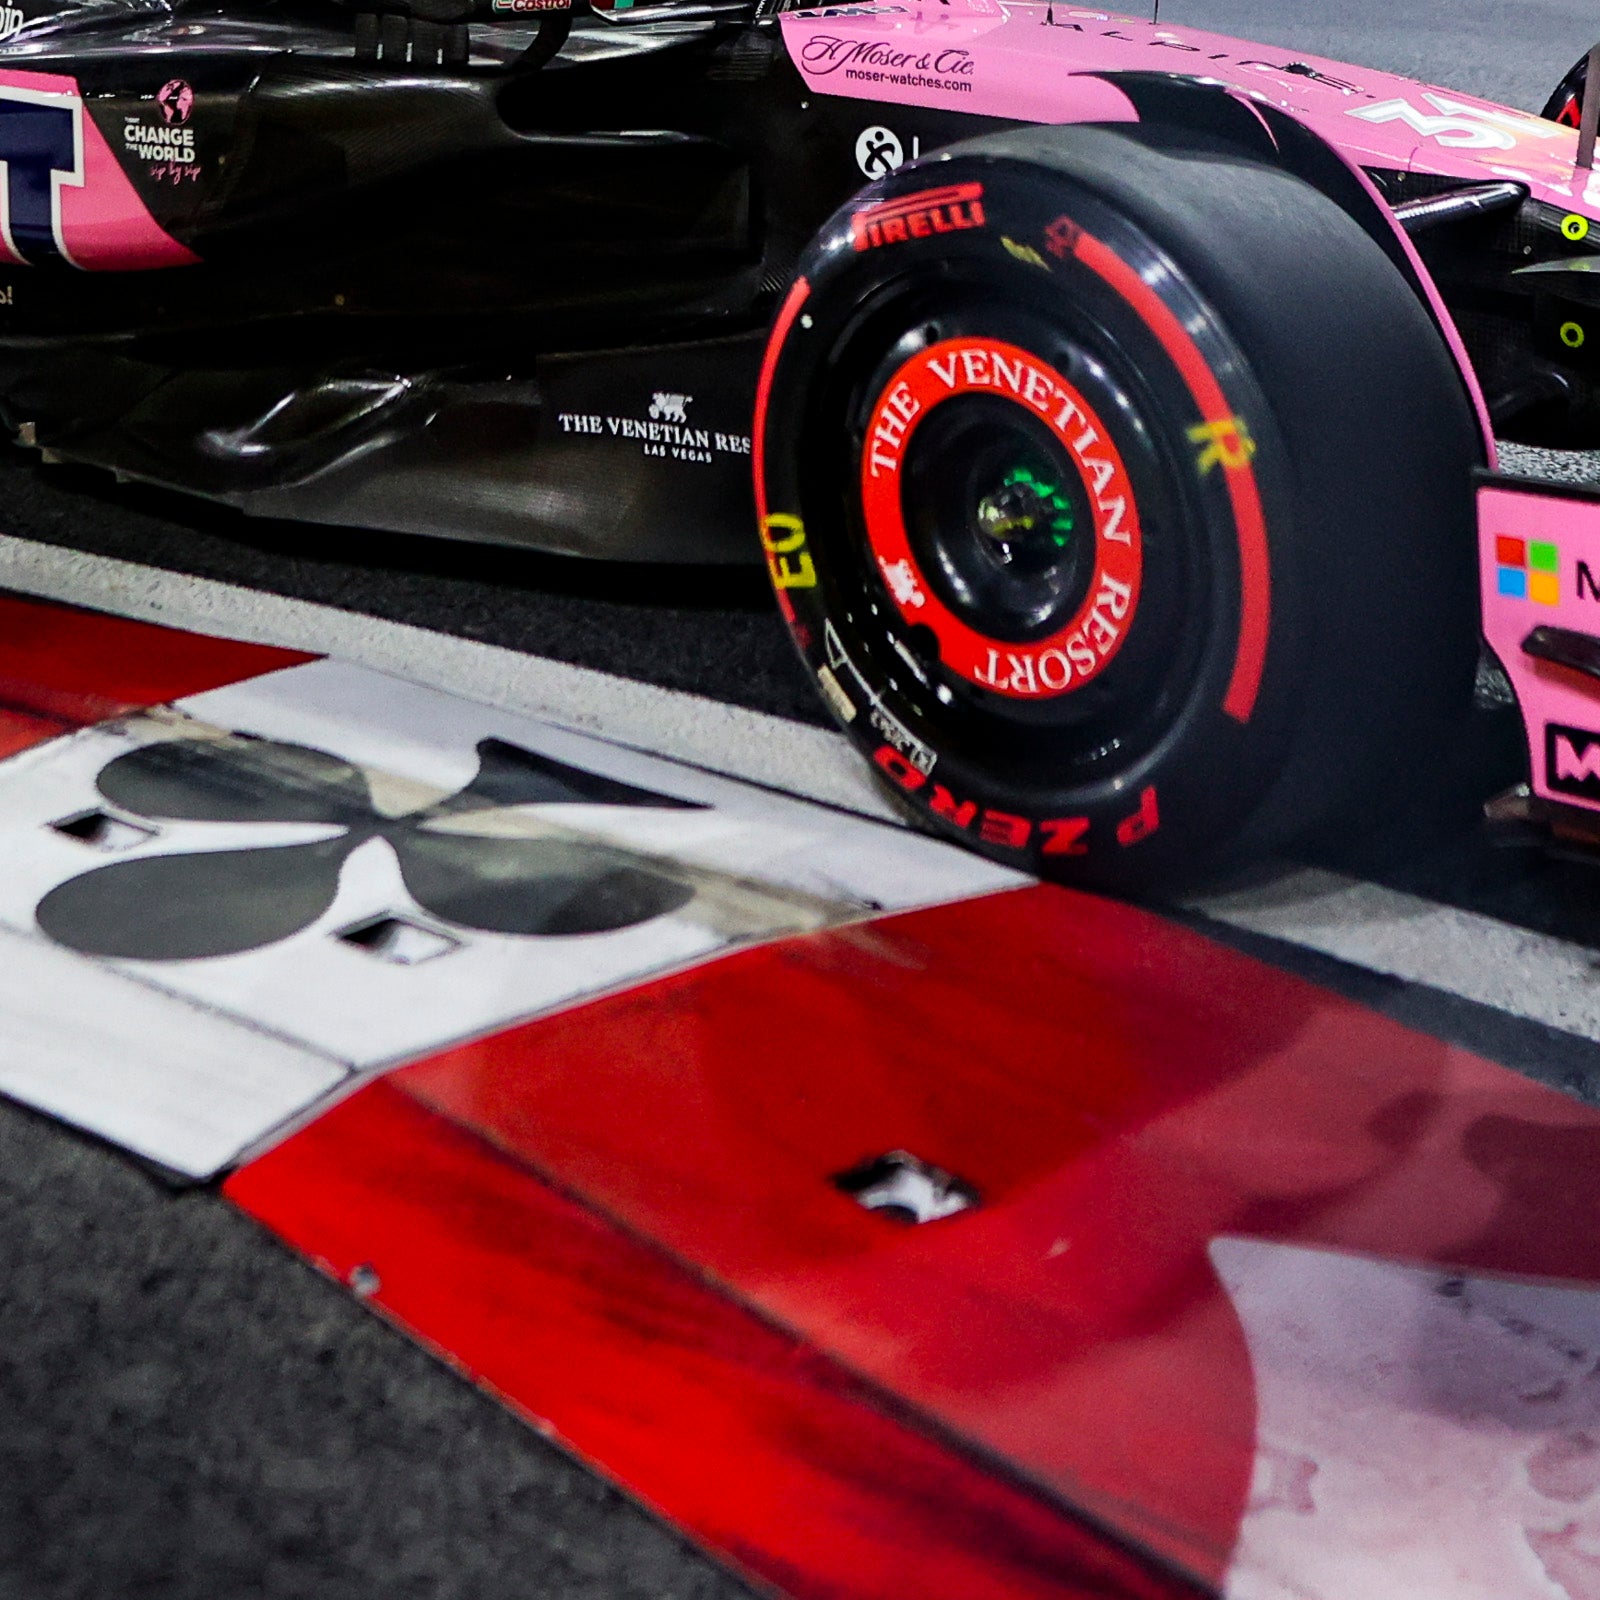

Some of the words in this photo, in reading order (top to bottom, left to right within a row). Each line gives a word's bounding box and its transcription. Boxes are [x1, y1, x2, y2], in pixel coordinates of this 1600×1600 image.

[845, 68, 973, 93] moser-watches.com
[915, 52, 931, 71] &
[124, 125, 195, 147] CHANGE
[139, 144, 196, 163] WORLD
[852, 182, 986, 252] PIRELLI
[559, 413, 602, 434] THE
[607, 417, 709, 448] VENETIAN
[715, 432, 751, 454] RES
[644, 443, 666, 457] LAS
[672, 447, 713, 463] VEGAS
[870, 380, 921, 480] THE
[928, 347, 1132, 547] VENETIAN
[974, 575, 1133, 693] RESORT
[874, 744, 1092, 855] ZERO
[1116, 785, 1160, 848] P
